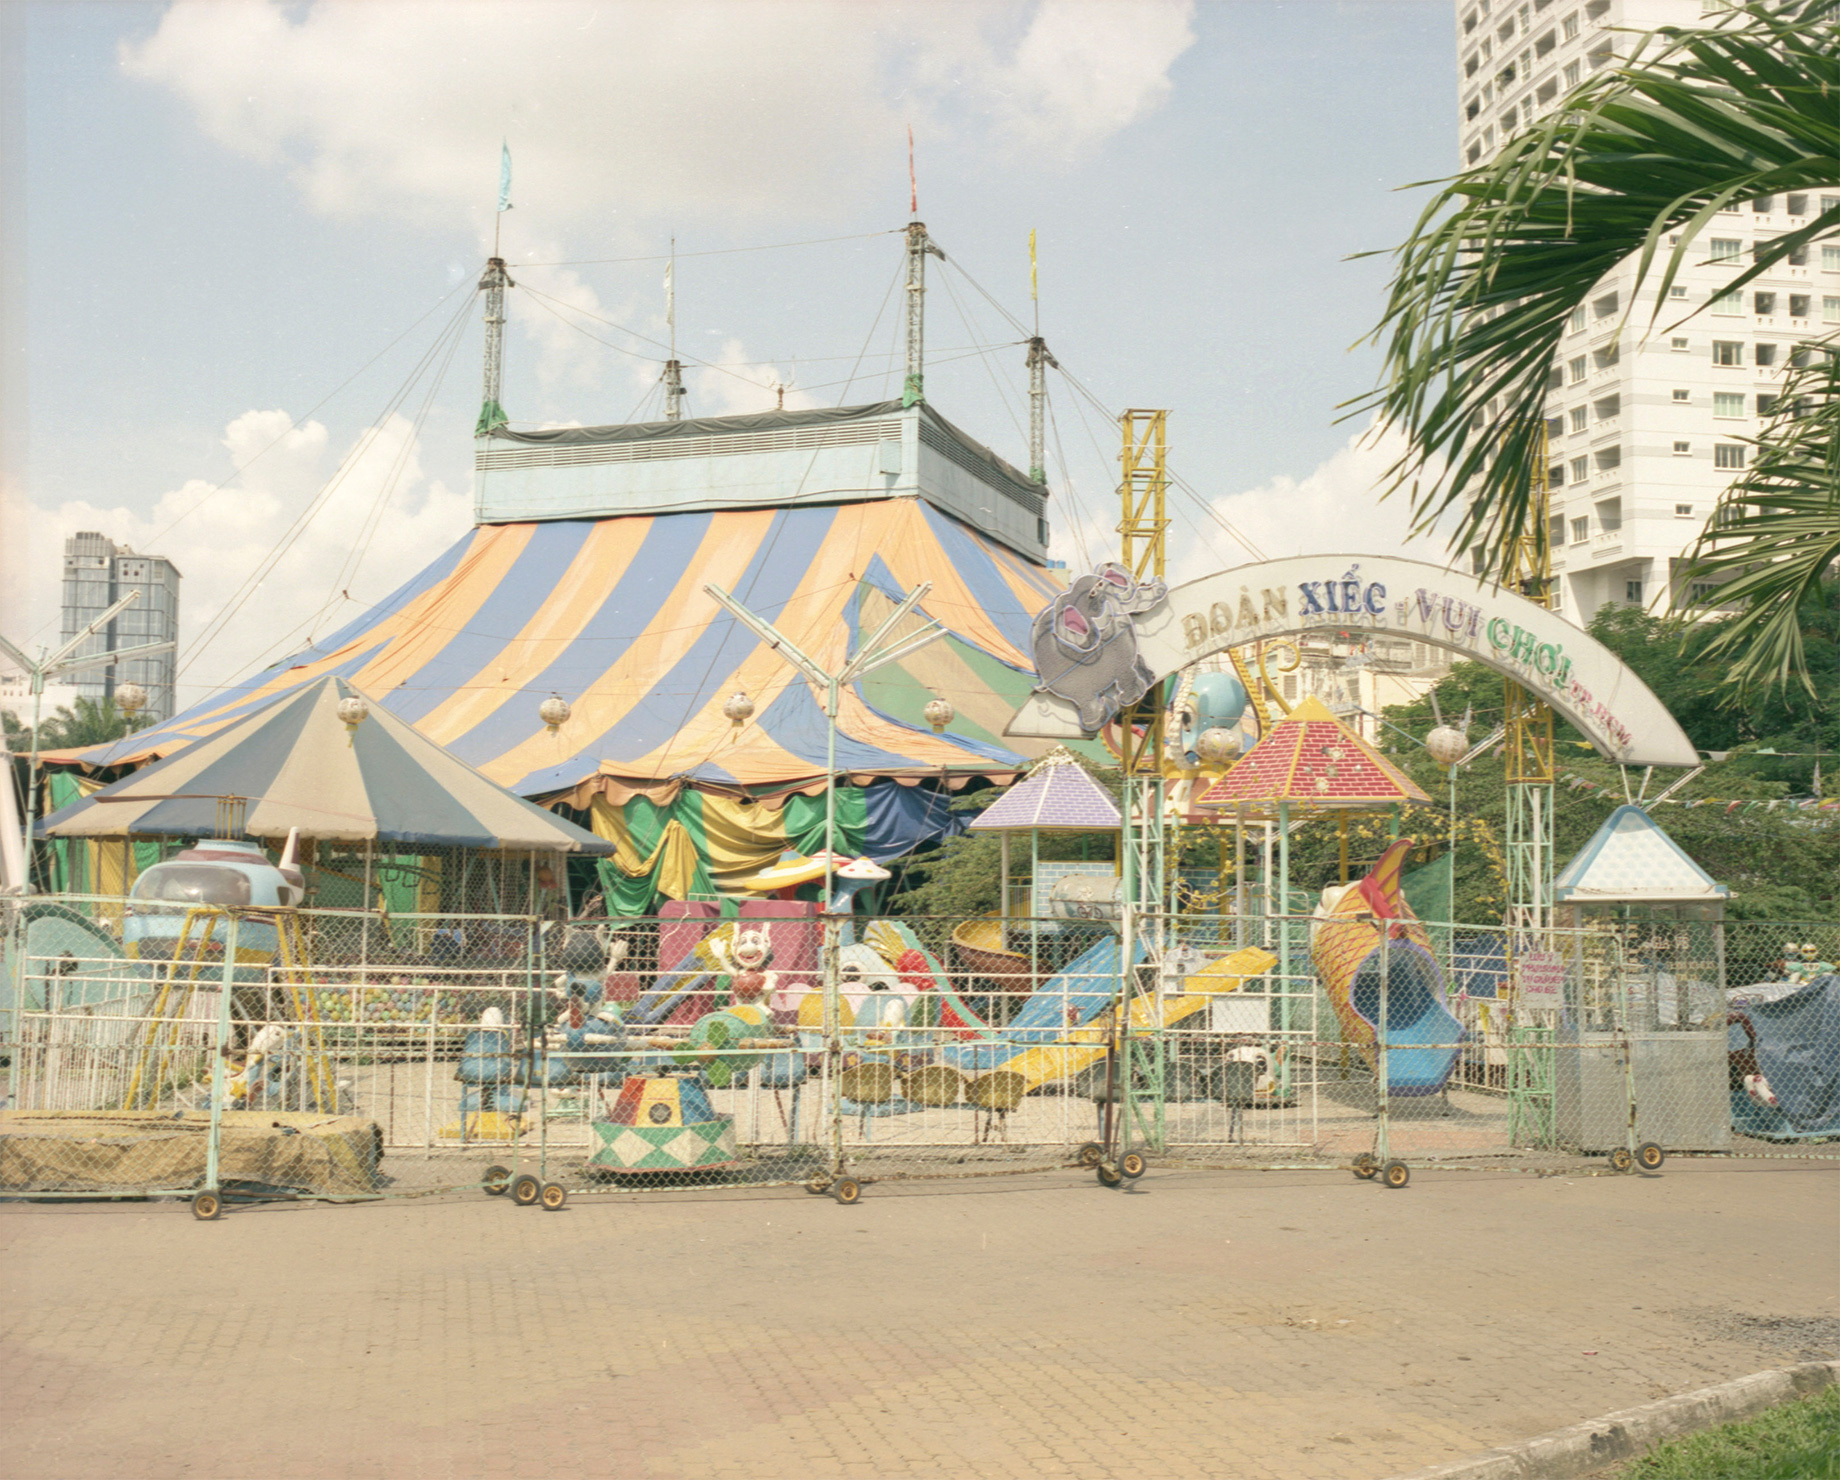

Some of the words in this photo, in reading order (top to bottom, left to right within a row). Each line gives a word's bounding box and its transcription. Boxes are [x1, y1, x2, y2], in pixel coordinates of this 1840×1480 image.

[1181, 585, 1288, 649] ĐOÀN
[1414, 587, 1483, 639] VUI
[1486, 616, 1572, 689] CHƠI
